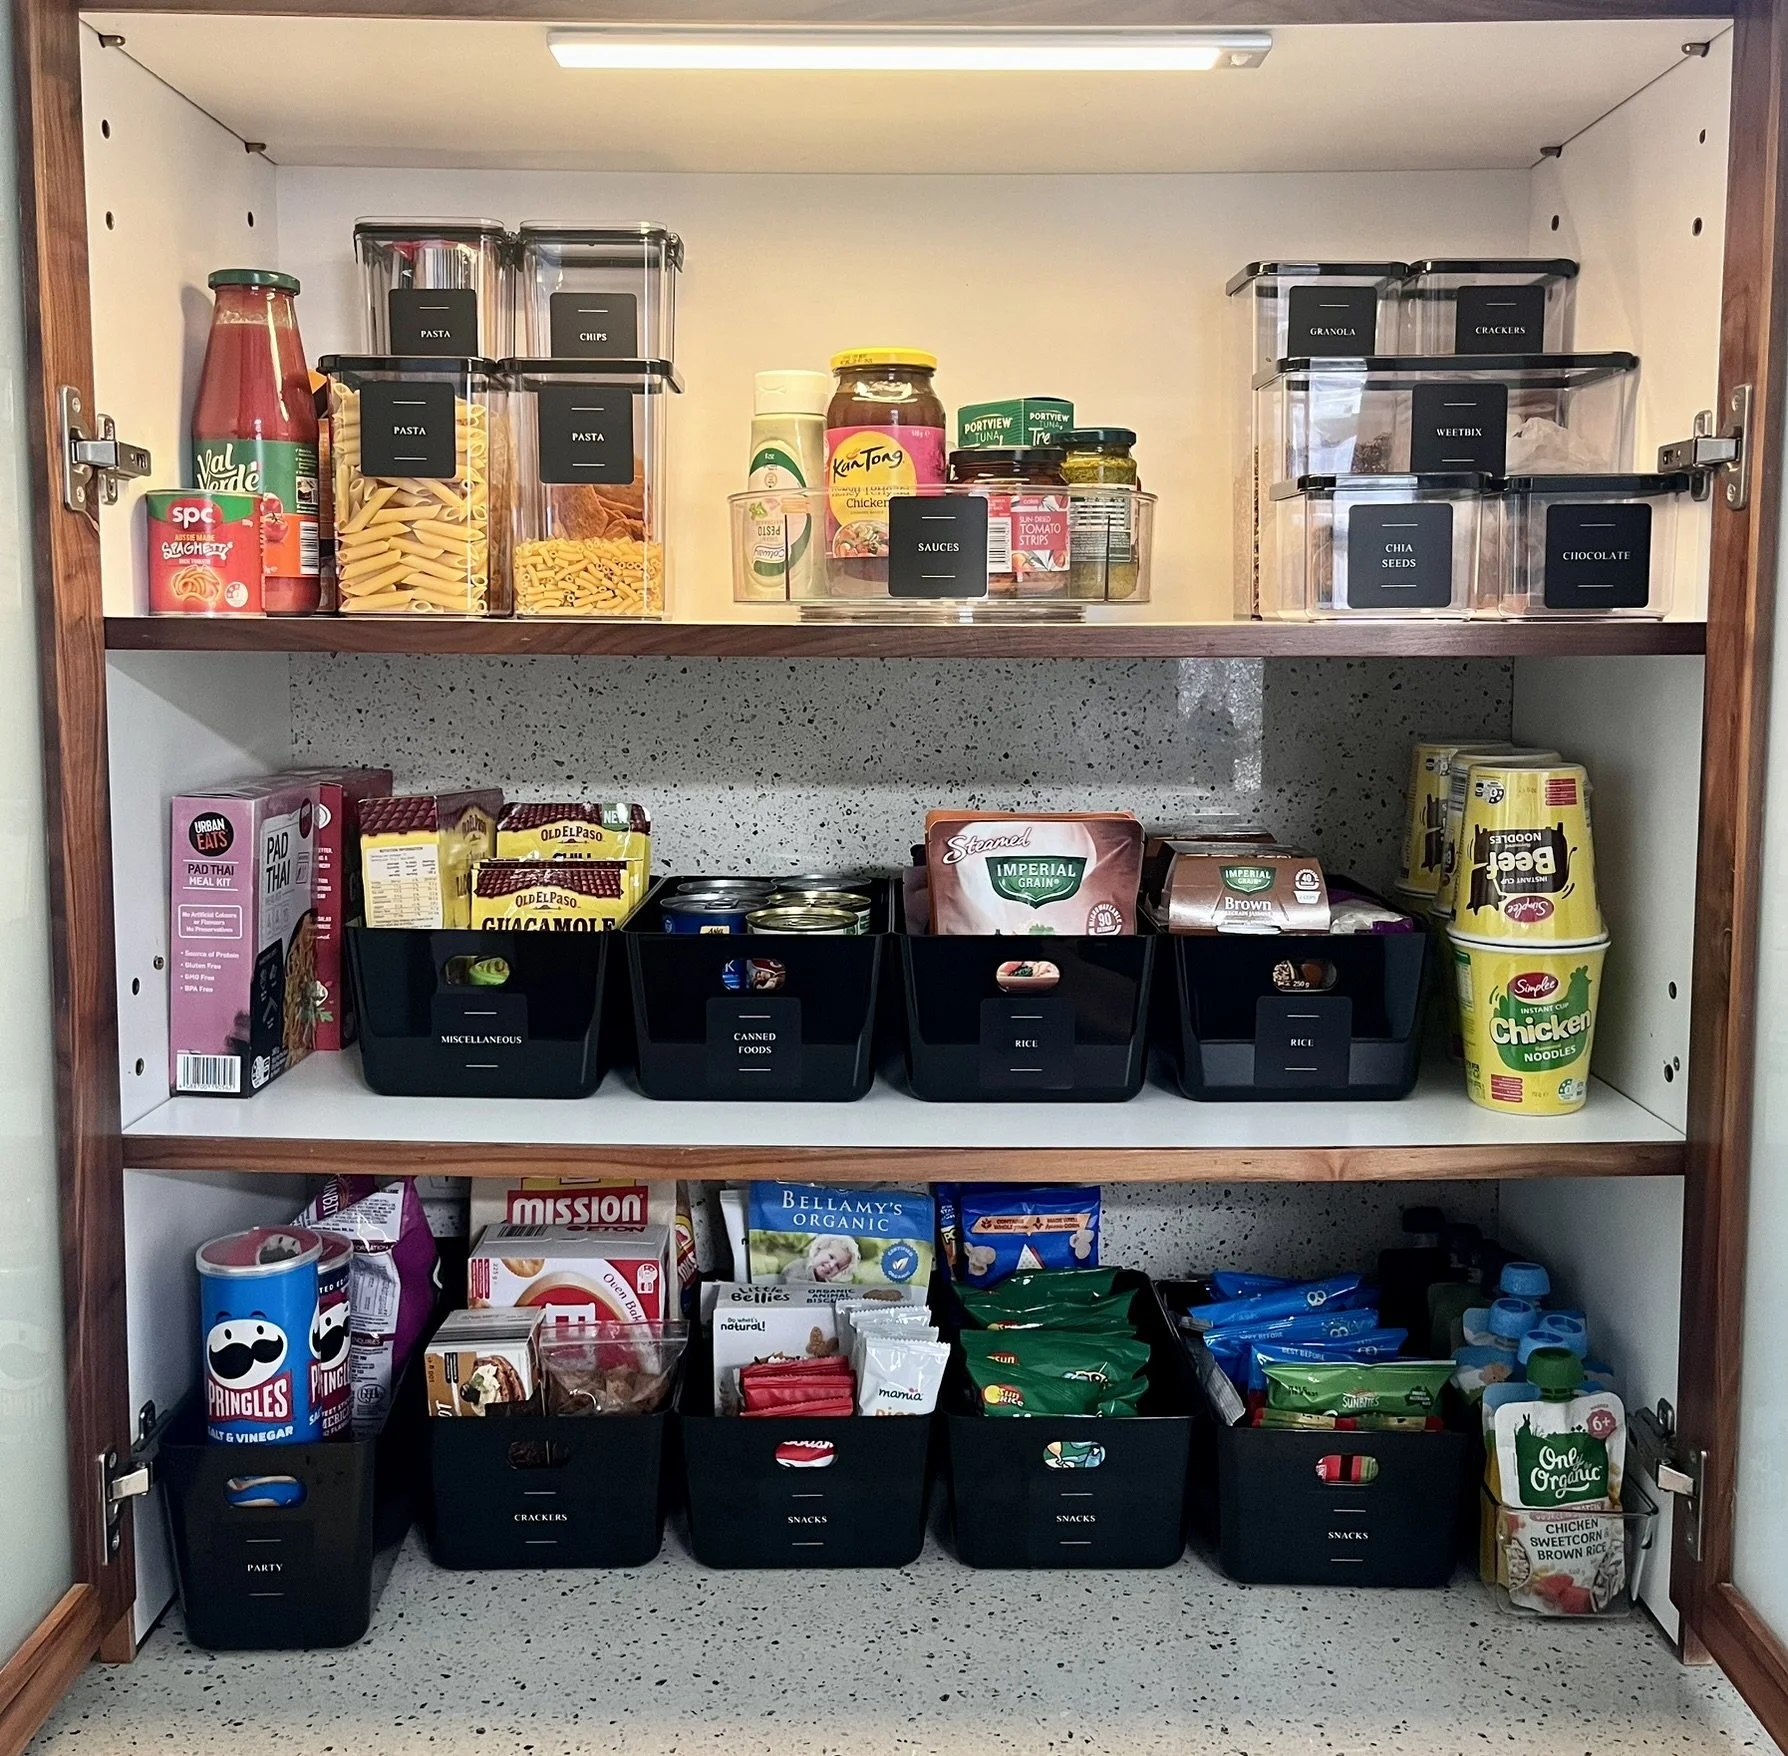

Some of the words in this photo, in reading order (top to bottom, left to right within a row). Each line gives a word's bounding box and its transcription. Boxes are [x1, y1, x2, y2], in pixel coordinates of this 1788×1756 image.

[421, 329, 451, 339] PASTA
[1310, 326, 1356, 337] GRANOLA
[1475, 325, 1526, 335] CRACKERS
[579, 332, 608, 342] CHIPS
[1030, 411, 1070, 422] PORTVIEW
[393, 426, 427, 436] PASTA
[964, 417, 1013, 435] PORTVIEW
[571, 432, 605, 442] PASTA
[975, 431, 1000, 442] TUNA
[1028, 427, 1051, 447] Tre
[1436, 427, 1482, 438] WEETBIX
[197, 443, 237, 478] Val
[197, 462, 261, 491] Verde
[172, 506, 214, 529] spc
[758, 525, 780, 536] PESTO
[1019, 522, 1062, 534] TOMATO
[1019, 534, 1049, 546] STRIPS
[161, 541, 233, 561] SPAGHETTI
[918, 542, 960, 552] SAUCES
[1385, 543, 1413, 553] CHIA
[1562, 550, 1631, 561] CHOCOLATE
[1381, 558, 1416, 568] SEEDS
[194, 818, 225, 833] URBAN
[541, 828, 561, 842] OLD
[562, 825, 576, 837] EL
[1489, 832, 1542, 846] NOODLES
[197, 831, 228, 851] EATS
[942, 826, 1032, 865] Steamed
[267, 832, 289, 864] PAD
[1486, 846, 1557, 880] Beef
[188, 864, 209, 876] PAD
[210, 864, 234, 876] THAI
[996, 863, 1077, 878] IMPERIAL
[1225, 869, 1271, 879] IMPERIAL
[189, 876, 215, 886] MEAL
[216, 876, 232, 887] KIT
[266, 859, 291, 894] THAI
[1018, 877, 1054, 888] GRAIN
[1301, 873, 1312, 882] 40
[1500, 876, 1516, 886] CUP
[1516, 876, 1548, 884] INSTANT
[515, 894, 536, 908] OLD
[536, 891, 549, 904] EL
[1225, 896, 1272, 911] Brown
[482, 917, 616, 931] GUACAMOLE
[1097, 911, 1112, 927] 90
[1520, 1005, 1553, 1014] INSTANT
[1555, 1002, 1570, 1011] CUP
[1489, 1009, 1591, 1046] Chicken
[441, 1035, 522, 1045] MISCELLANEOUS
[733, 1031, 776, 1041] CANNED
[1290, 1037, 1314, 1047] RICE
[1015, 1038, 1039, 1048] RICE
[738, 1045, 772, 1055] FOODS
[1524, 1044, 1577, 1063] NOODLES
[782, 1190, 903, 1216] BELLAMY'S
[793, 1213, 889, 1232] ORGANIC
[603, 1273, 628, 1300] Oven
[625, 1300, 643, 1322] Bak
[731, 1292, 790, 1304] Bellies
[720, 1321, 766, 1332] natural!
[208, 1378, 289, 1419] PRINGLES
[878, 1387, 922, 1402] mamia
[1342, 1397, 1380, 1408] SUNBITES
[1592, 1416, 1611, 1431] 6+
[226, 1432, 235, 1442] &
[235, 1425, 294, 1443] VINEGAR
[1539, 1445, 1586, 1472] Only
[1530, 1466, 1601, 1499] Organic
[513, 1513, 568, 1522] CRACKERS
[787, 1515, 828, 1524] SNACKS
[1056, 1514, 1096, 1523] SNACKS
[1545, 1518, 1599, 1535] CHICKEN
[1328, 1531, 1369, 1540] SNACKS
[1530, 1529, 1603, 1548] SWEETCORN
[1537, 1547, 1583, 1561] BROWN
[247, 1562, 284, 1573] PARTY
